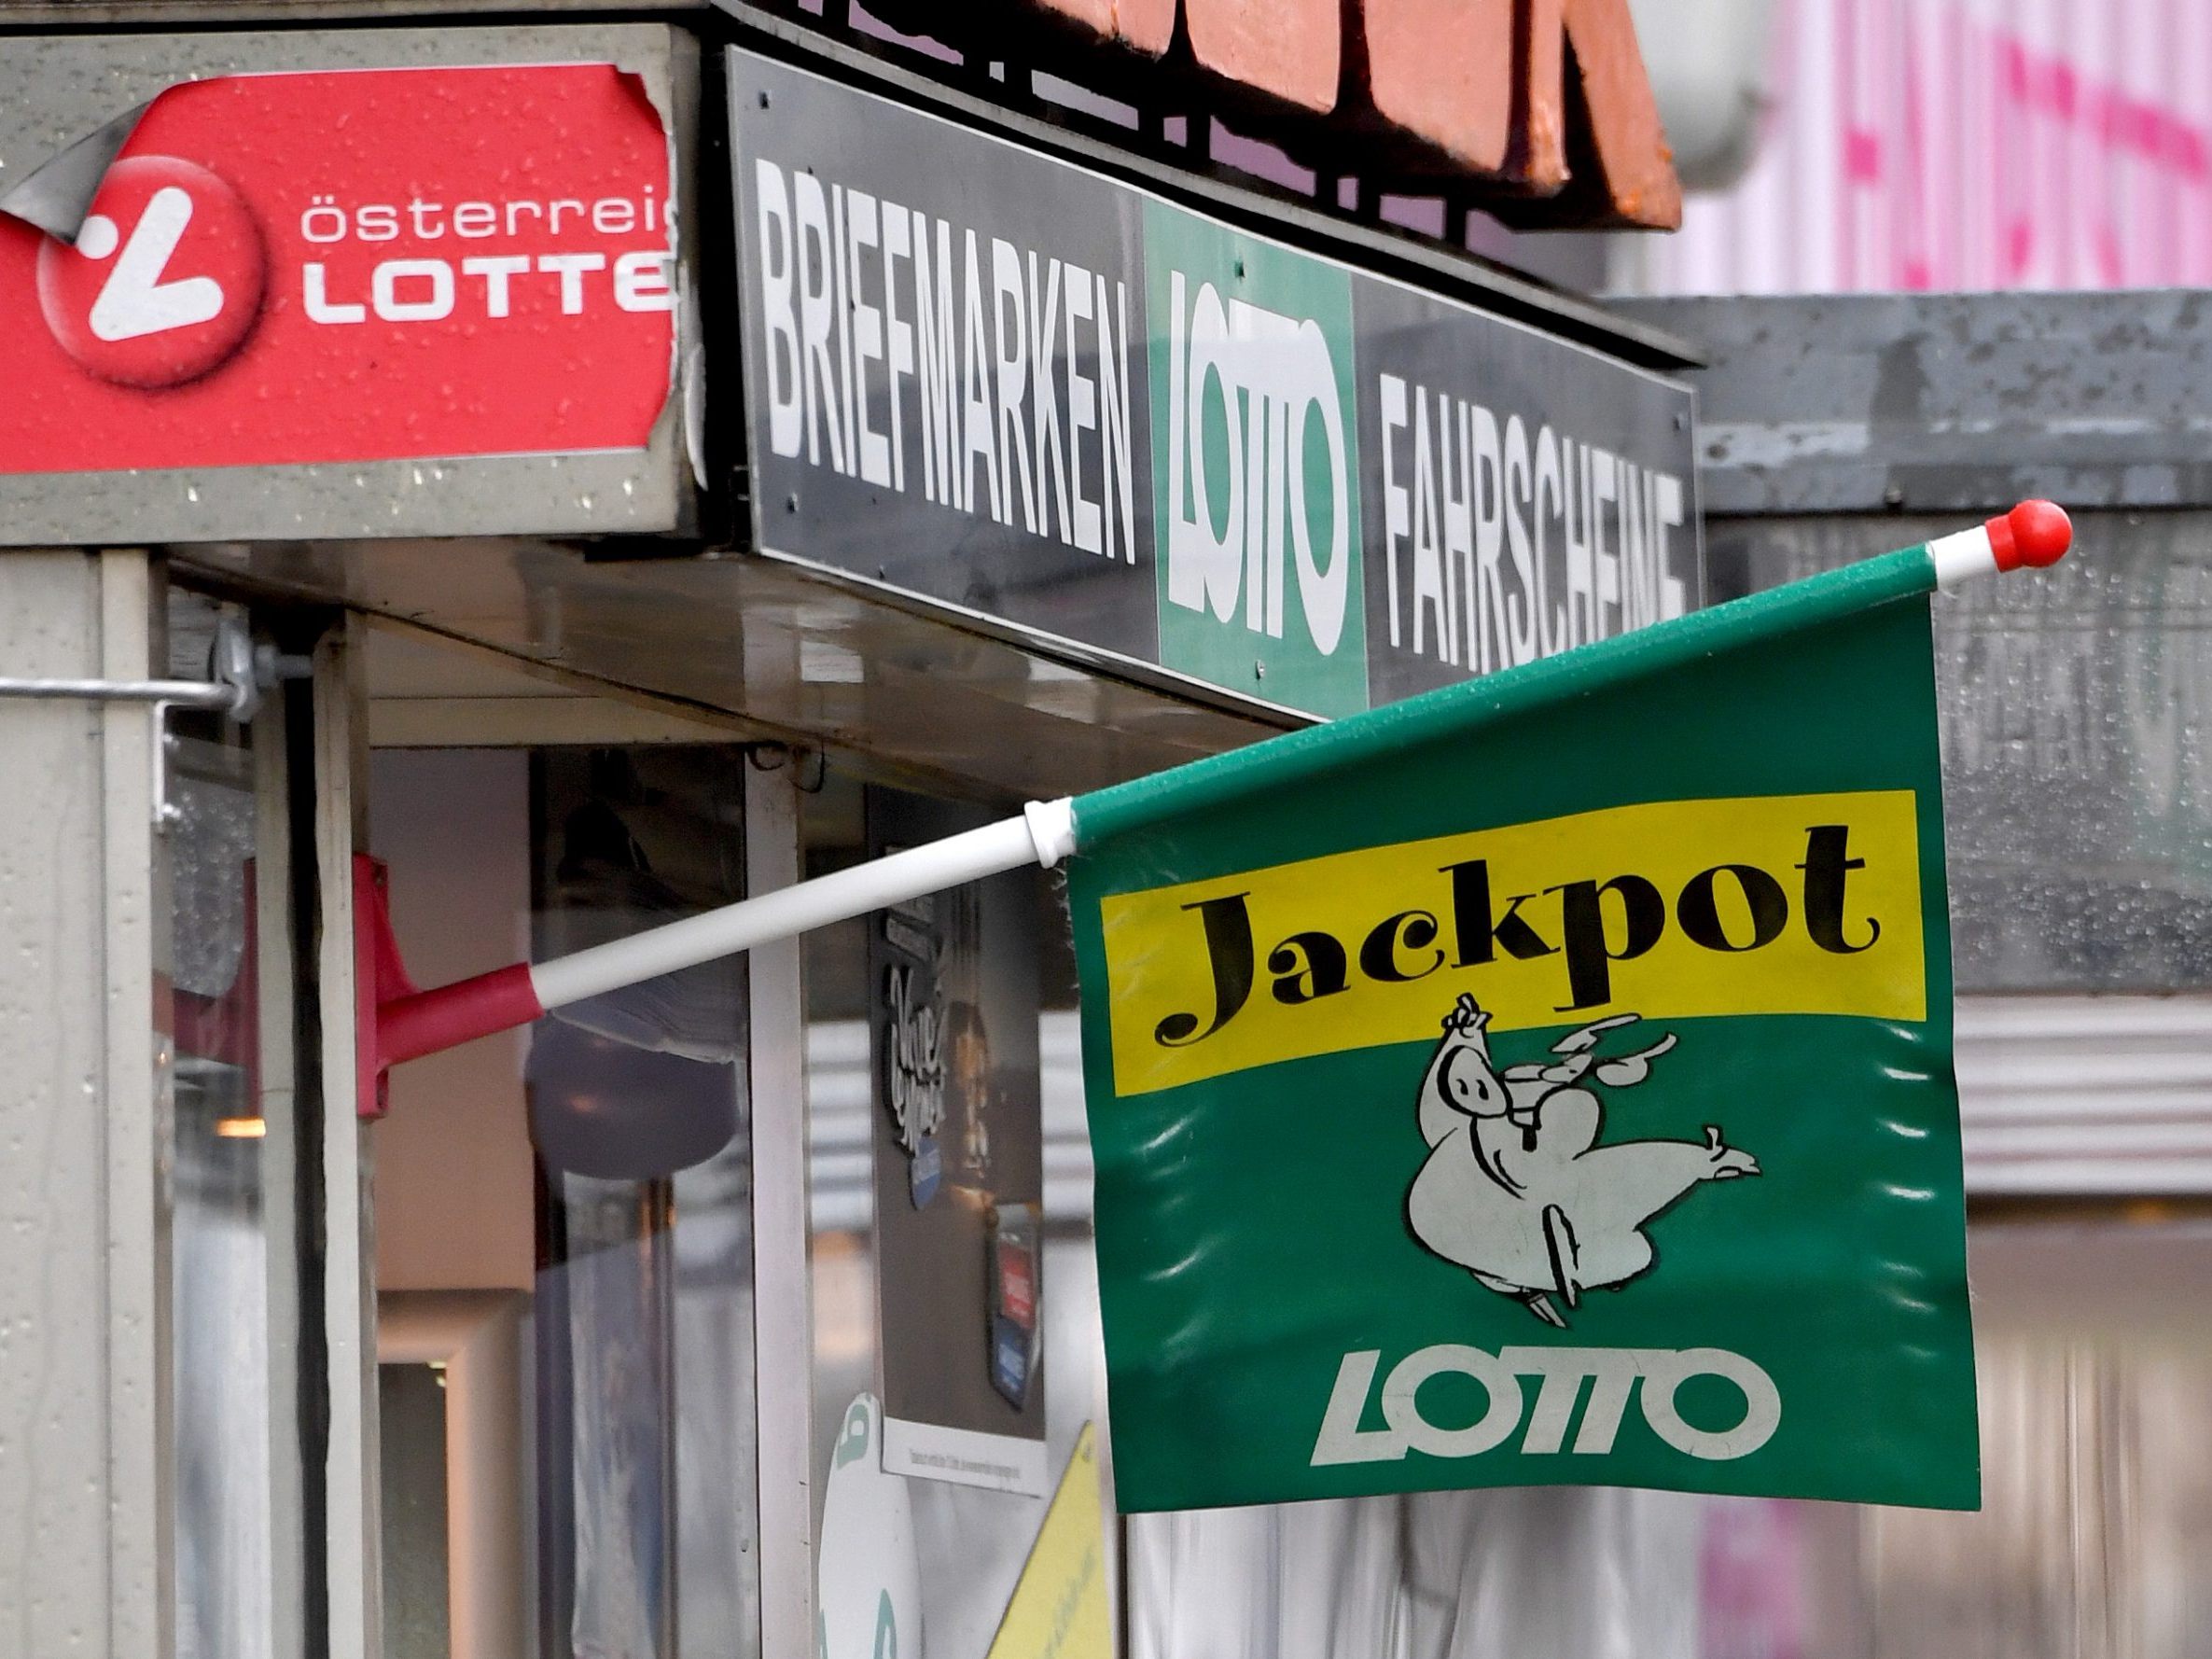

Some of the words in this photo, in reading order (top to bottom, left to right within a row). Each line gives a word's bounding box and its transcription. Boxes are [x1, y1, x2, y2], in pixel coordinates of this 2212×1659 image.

[301, 250, 679, 324] LOTTE
[756, 157, 1136, 565] BRIEFMARKEN
[1168, 270, 1348, 656] LOTTO
[1380, 372, 1686, 676] FAHRSCHEINE
[1154, 824, 1882, 1048] Jackpot
[1310, 1344, 1782, 1466] LOTTO
